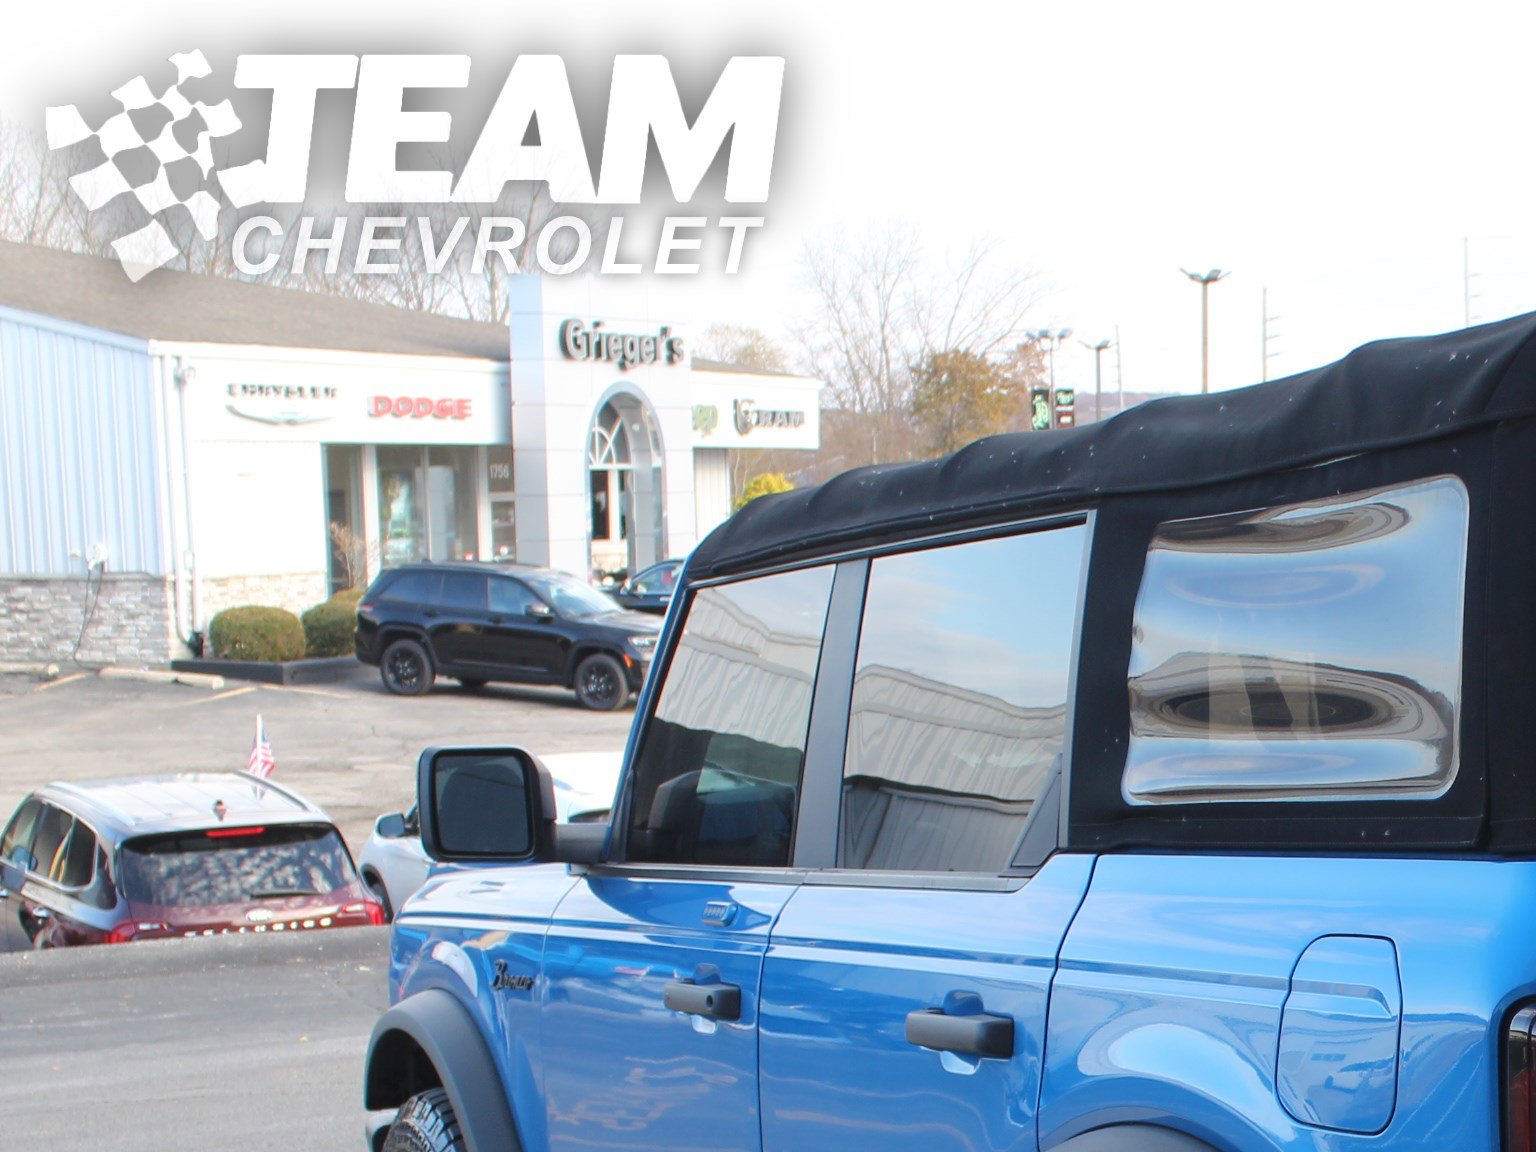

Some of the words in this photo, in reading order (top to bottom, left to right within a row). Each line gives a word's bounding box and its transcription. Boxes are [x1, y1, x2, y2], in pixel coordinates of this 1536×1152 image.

[559, 318, 684, 370] Grieger's
[368, 395, 473, 420] DODGE
[490, 464, 510, 479] 1756
